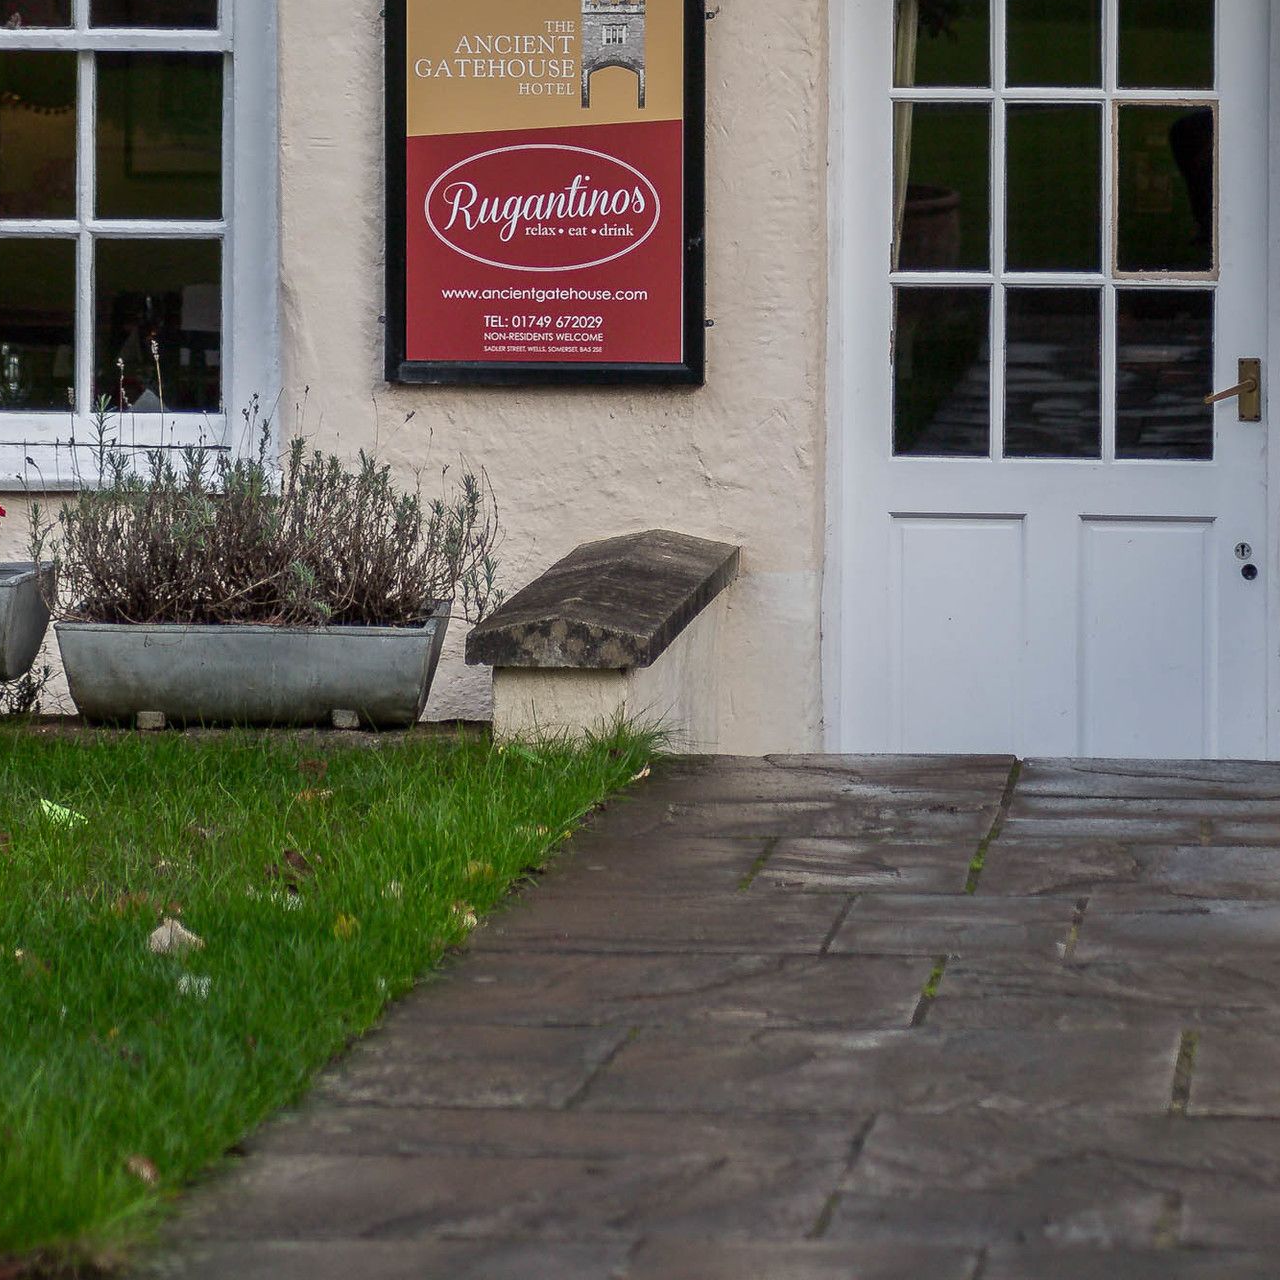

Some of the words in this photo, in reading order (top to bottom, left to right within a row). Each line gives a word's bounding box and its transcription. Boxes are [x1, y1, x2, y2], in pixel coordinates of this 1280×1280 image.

[543, 20, 575, 33] THE
[454, 35, 575, 55] ANCIENT
[414, 58, 575, 79] GATEHOUSE
[518, 82, 575, 96] HOTEL
[443, 174, 646, 242] Rugantinos
[525, 223, 556, 237] relax
[568, 225, 587, 237] eat
[599, 223, 634, 237] drink
[441, 286, 648, 303] www.ancientgatehouse.com
[484, 315, 508, 328] TEL:
[512, 315, 552, 328] 01749
[556, 315, 603, 328] 672029
[484, 332, 553, 341] NON-RESIDENTS
[556, 332, 603, 342] WELCOME
